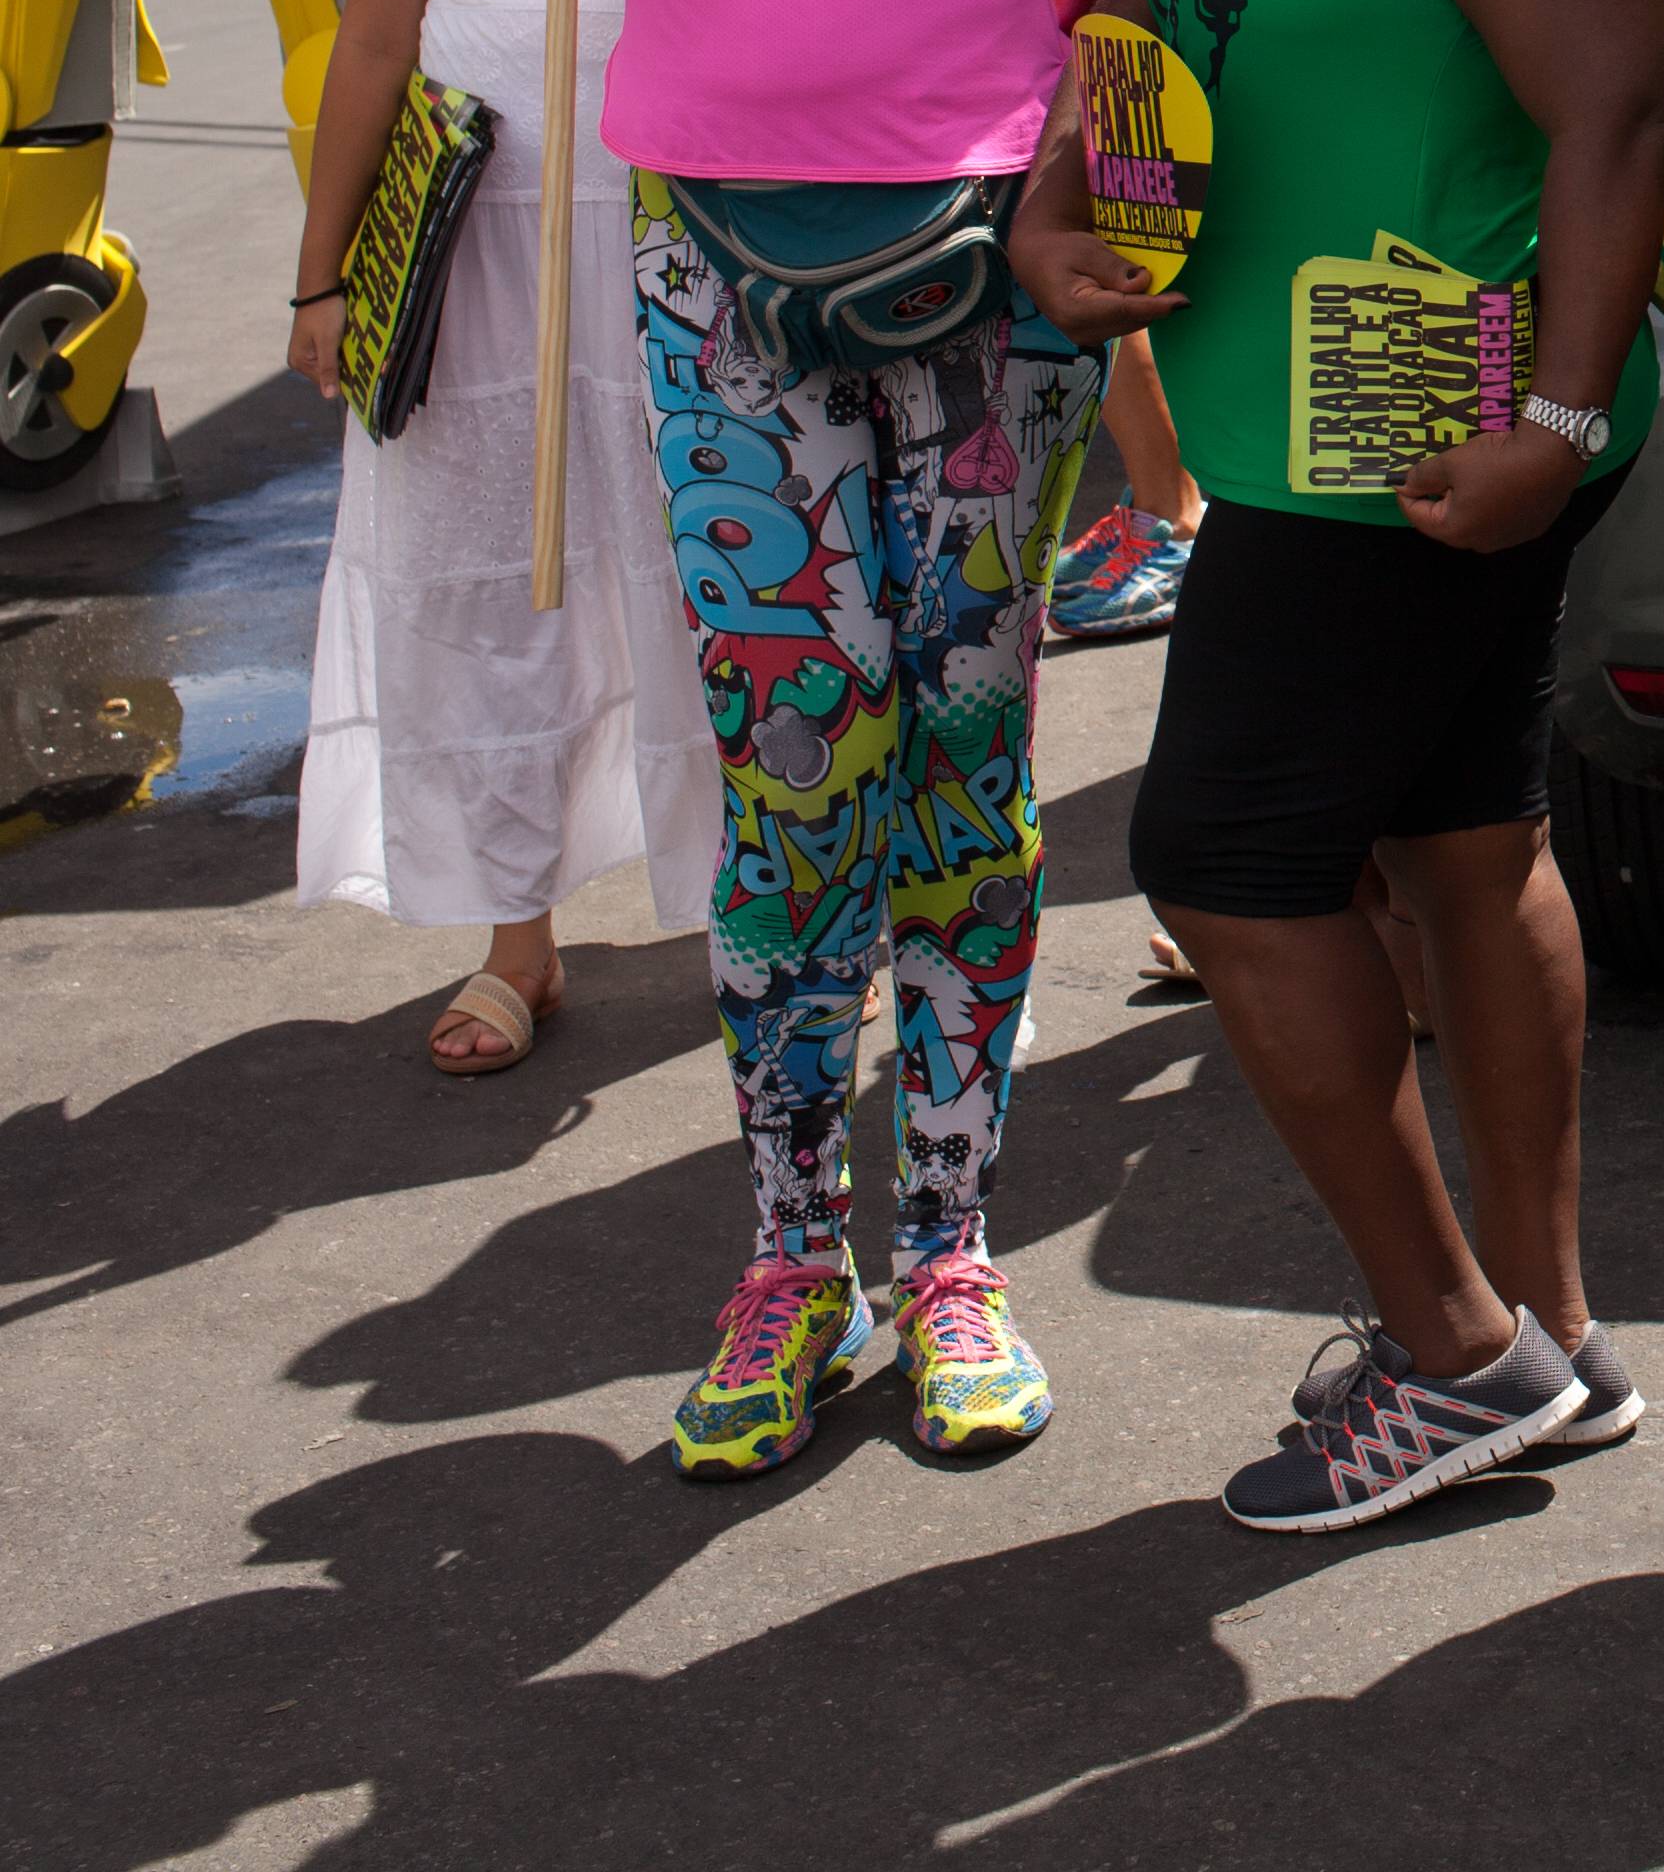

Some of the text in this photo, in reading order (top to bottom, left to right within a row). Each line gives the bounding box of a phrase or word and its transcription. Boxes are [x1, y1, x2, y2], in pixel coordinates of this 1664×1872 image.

[1079, 32, 1166, 94] TRABALHO
[1103, 155, 1179, 206] APARECE
[1125, 203, 1190, 239] VENTAROLA
[1309, 283, 1351, 486] O TRABALHO
[1350, 282, 1390, 487] INFANTIL E A
[1419, 290, 1478, 454] EXUAL
[1479, 293, 1512, 432] APARECEM
